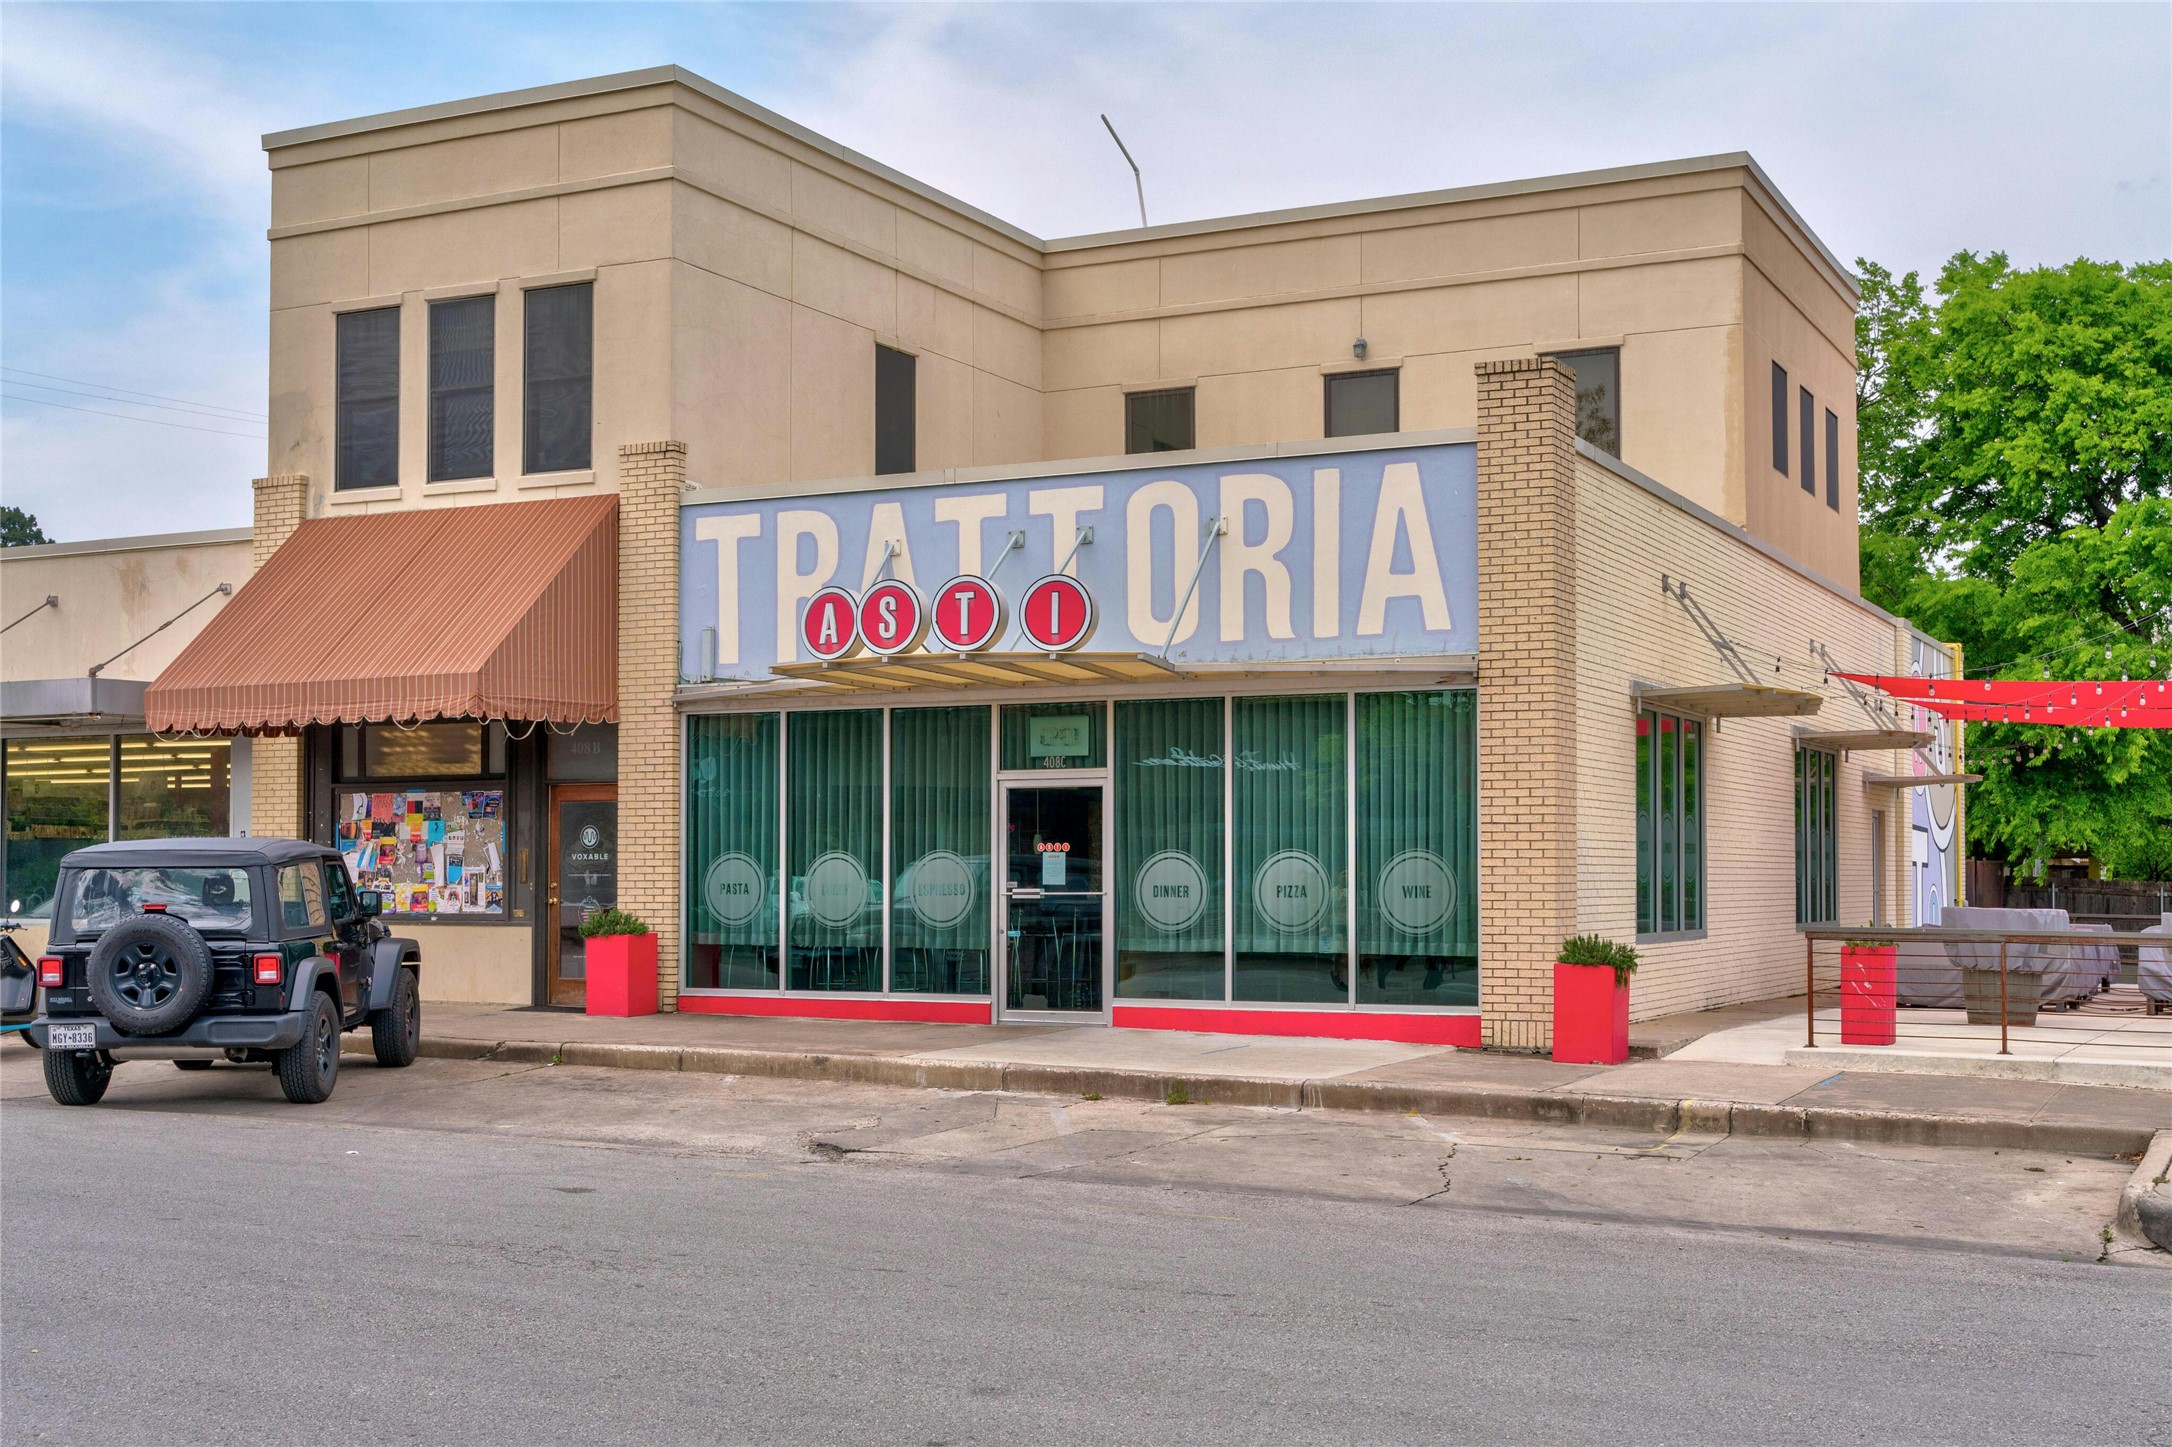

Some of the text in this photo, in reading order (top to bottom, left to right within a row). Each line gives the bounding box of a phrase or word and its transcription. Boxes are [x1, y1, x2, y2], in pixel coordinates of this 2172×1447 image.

[694, 461, 1452, 665] TRATTORIA
[816, 589, 1062, 647] ASTI
[1043, 756, 1067, 768] 408C
[571, 853, 609, 861] VOXABLE
[719, 882, 750, 895] PASTA
[917, 883, 966, 896] ESPRESSO
[1153, 885, 1189, 898] DINNER
[1276, 885, 1308, 898] PIZZA
[1402, 885, 1432, 899] WINE
